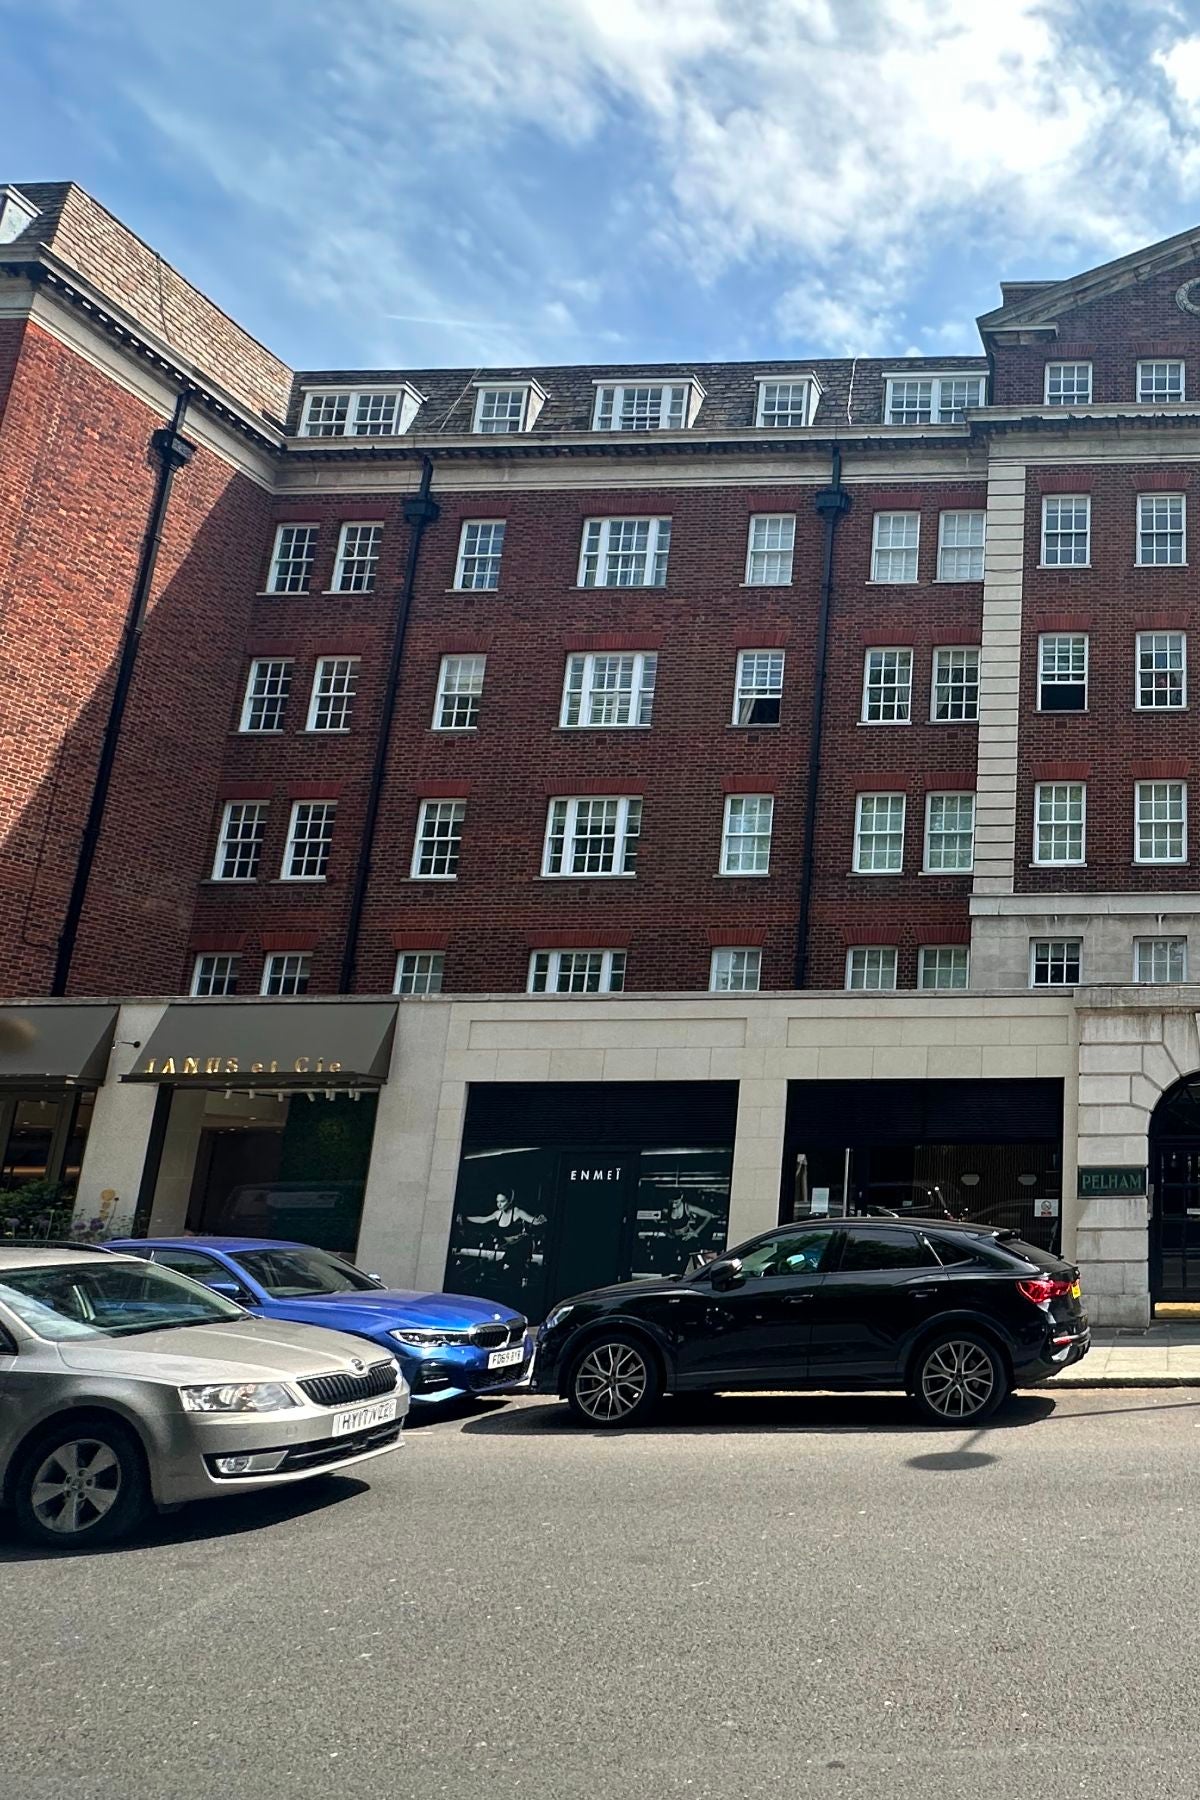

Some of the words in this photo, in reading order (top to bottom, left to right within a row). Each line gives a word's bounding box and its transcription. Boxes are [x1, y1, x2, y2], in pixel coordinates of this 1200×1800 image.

[294, 1056, 343, 1074] Cie
[570, 1167, 622, 1181] ENMEÏ
[1082, 1174, 1142, 1189] PELHAM
